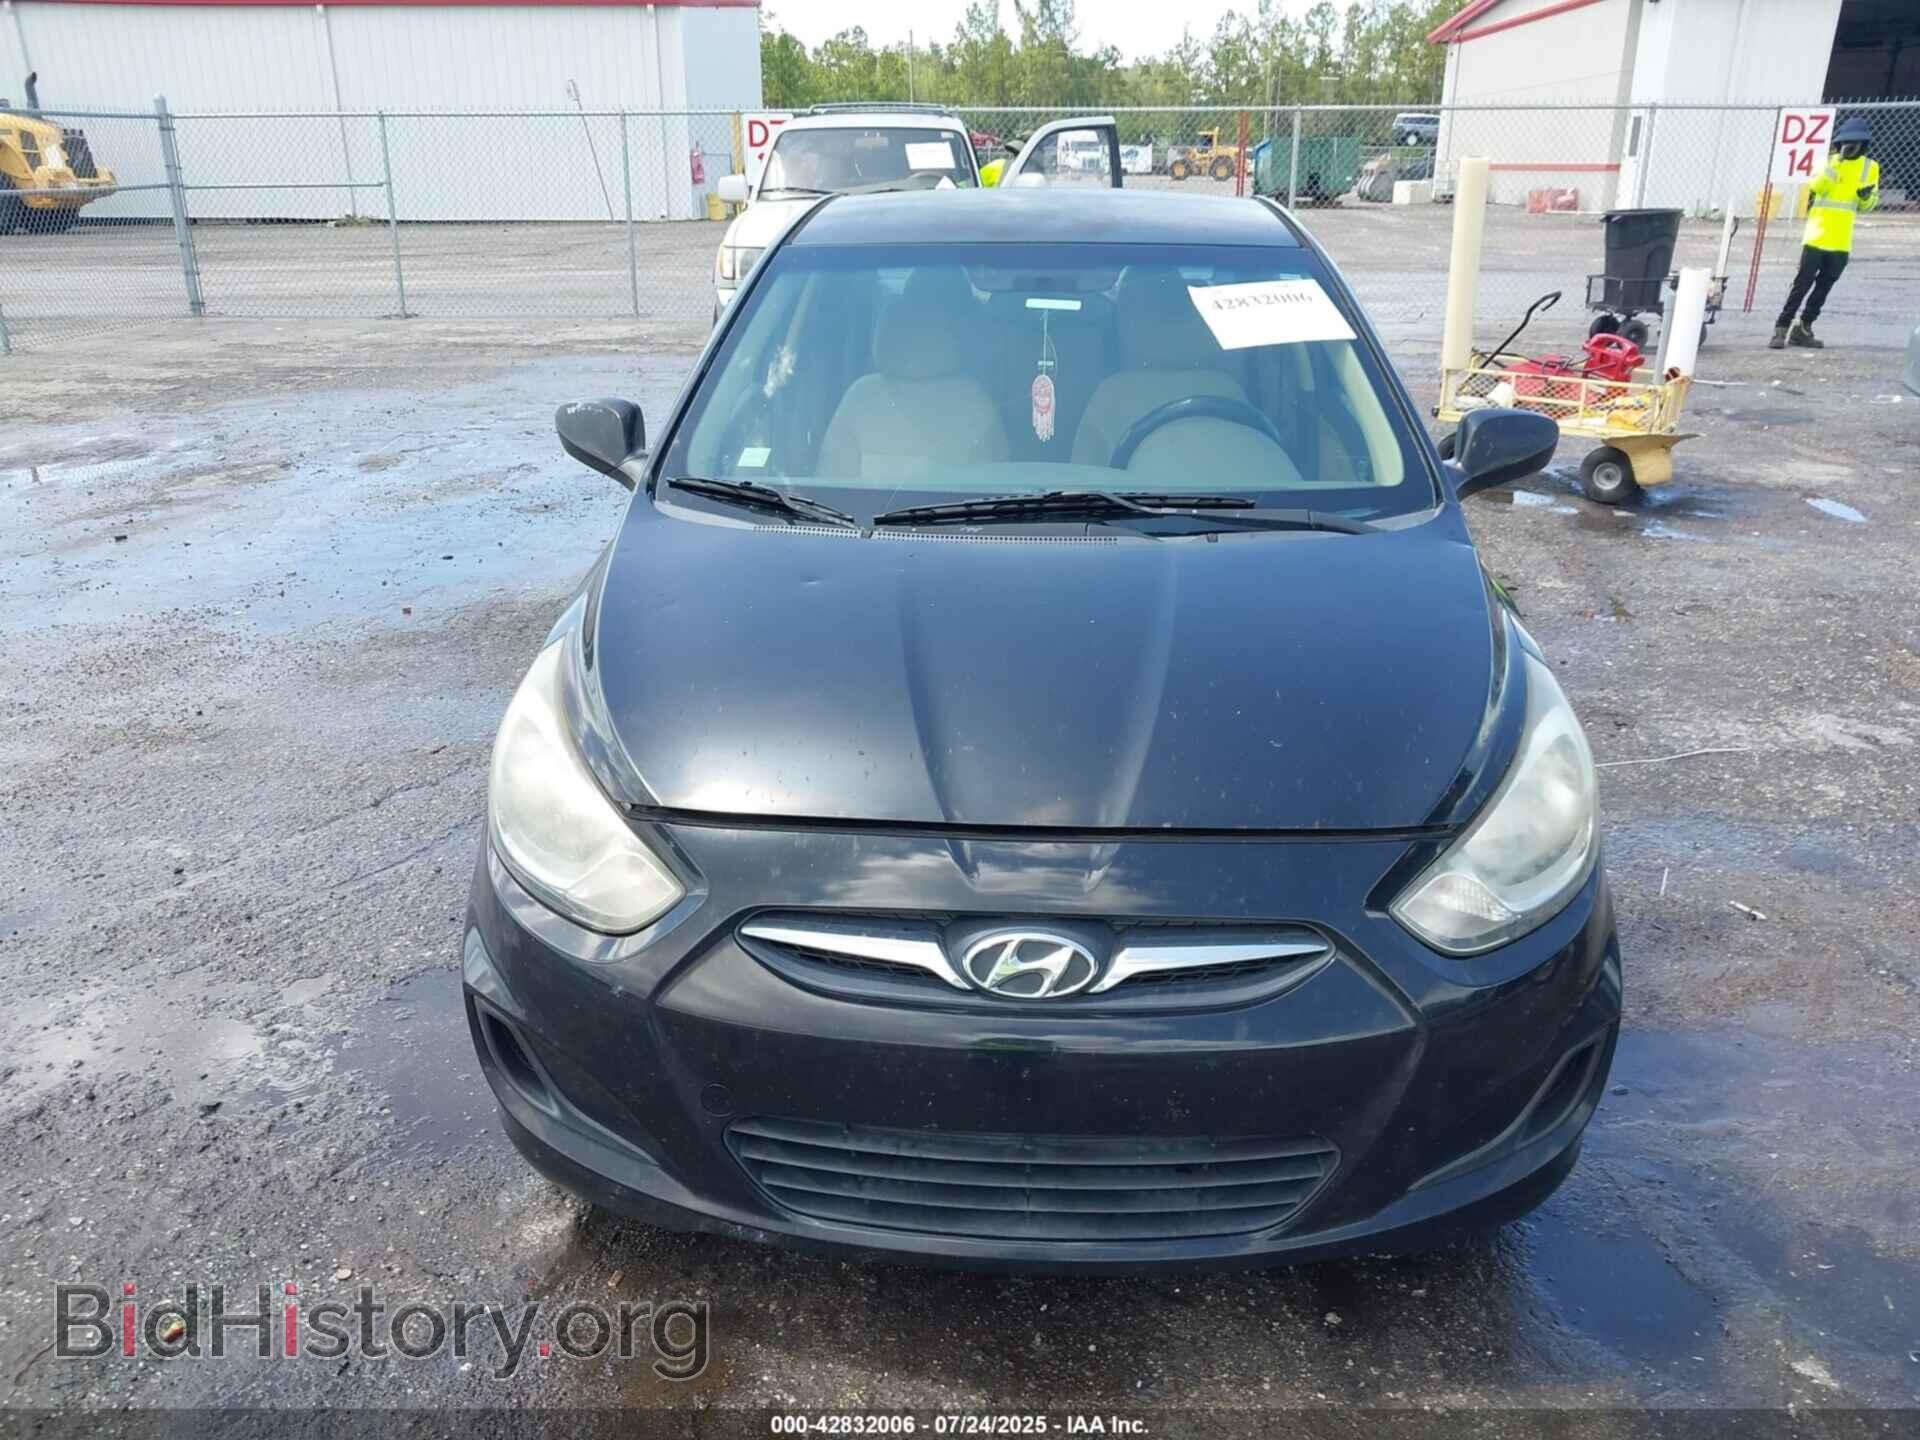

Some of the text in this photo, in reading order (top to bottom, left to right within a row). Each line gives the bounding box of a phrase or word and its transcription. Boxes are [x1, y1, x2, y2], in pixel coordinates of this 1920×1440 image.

[748, 119, 784, 147] D
[1782, 115, 1829, 144] DZ
[1788, 148, 1814, 177] 14
